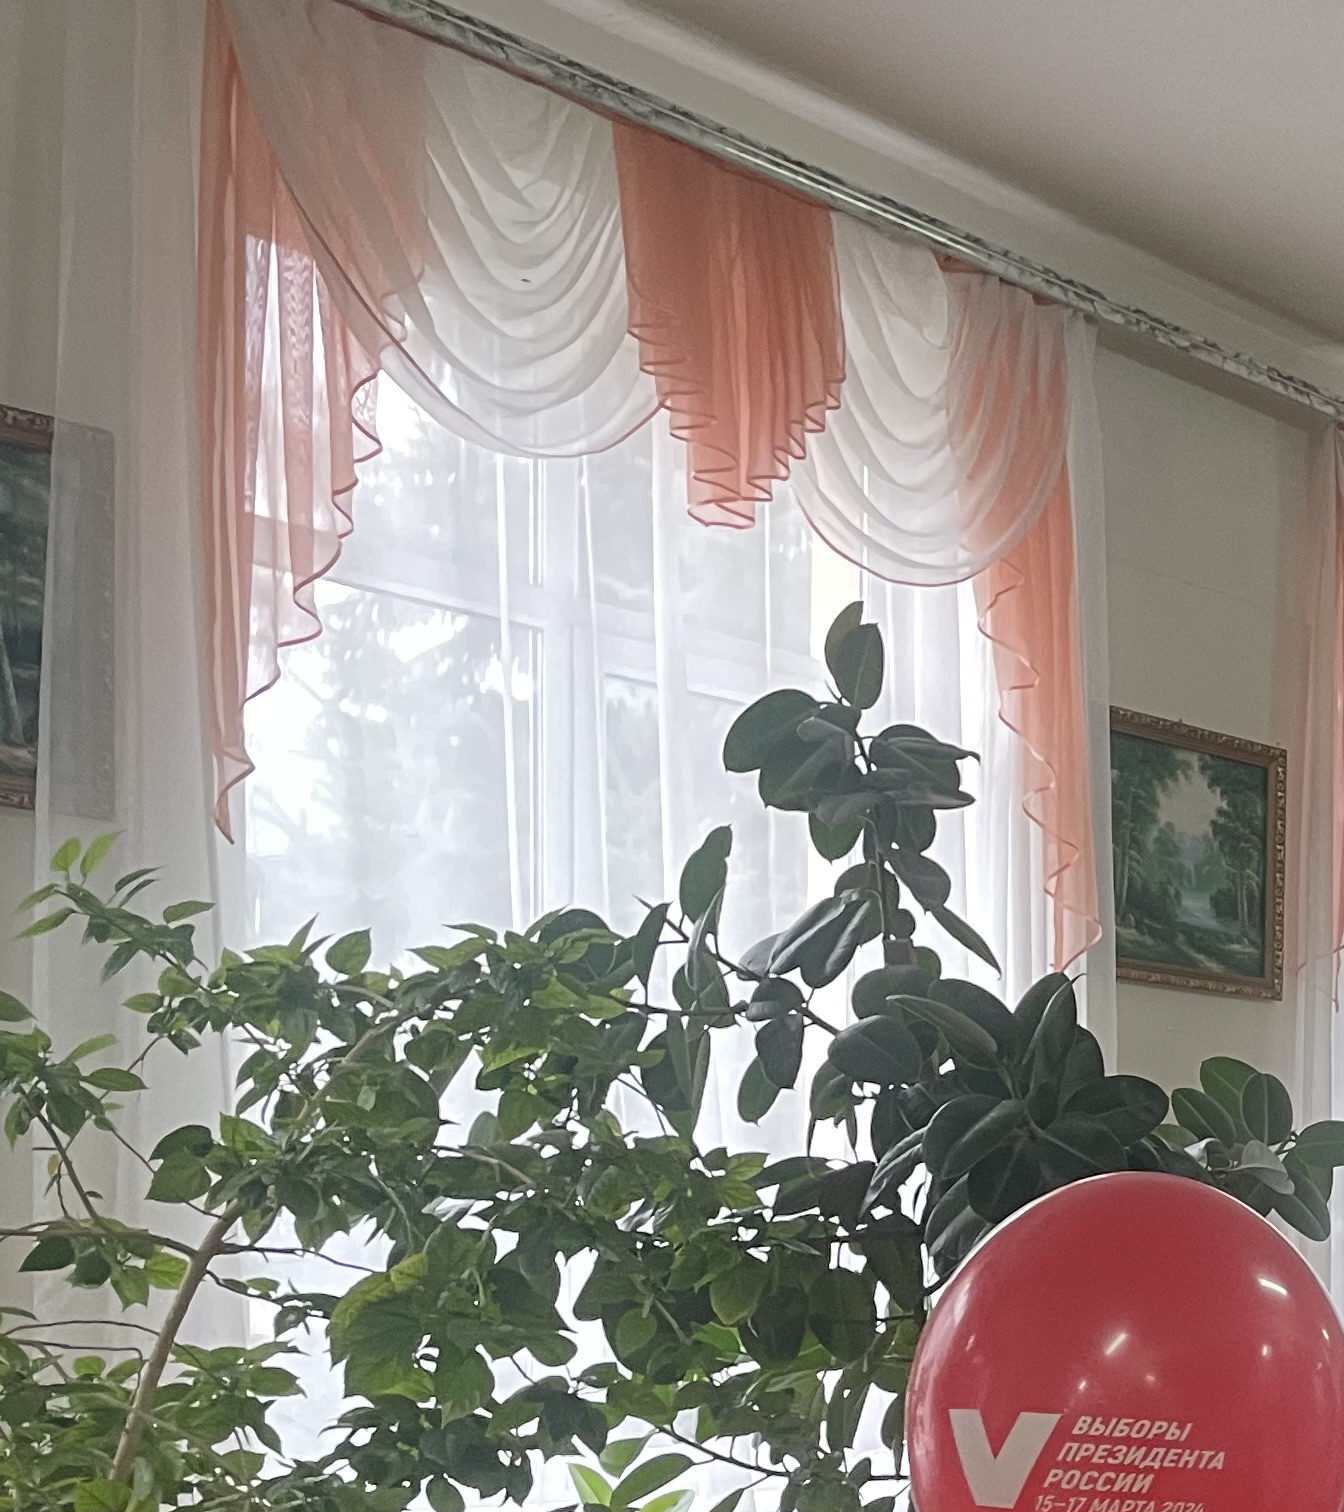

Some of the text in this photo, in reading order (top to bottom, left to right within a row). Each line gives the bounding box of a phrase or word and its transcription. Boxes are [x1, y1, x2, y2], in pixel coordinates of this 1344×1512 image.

[1072, 1415, 1193, 1441] ВЫБОРЫ
[1056, 1442, 1225, 1470] ПРЕЗИДЕНТА
[1043, 1469, 1155, 1494] РОССИИ
